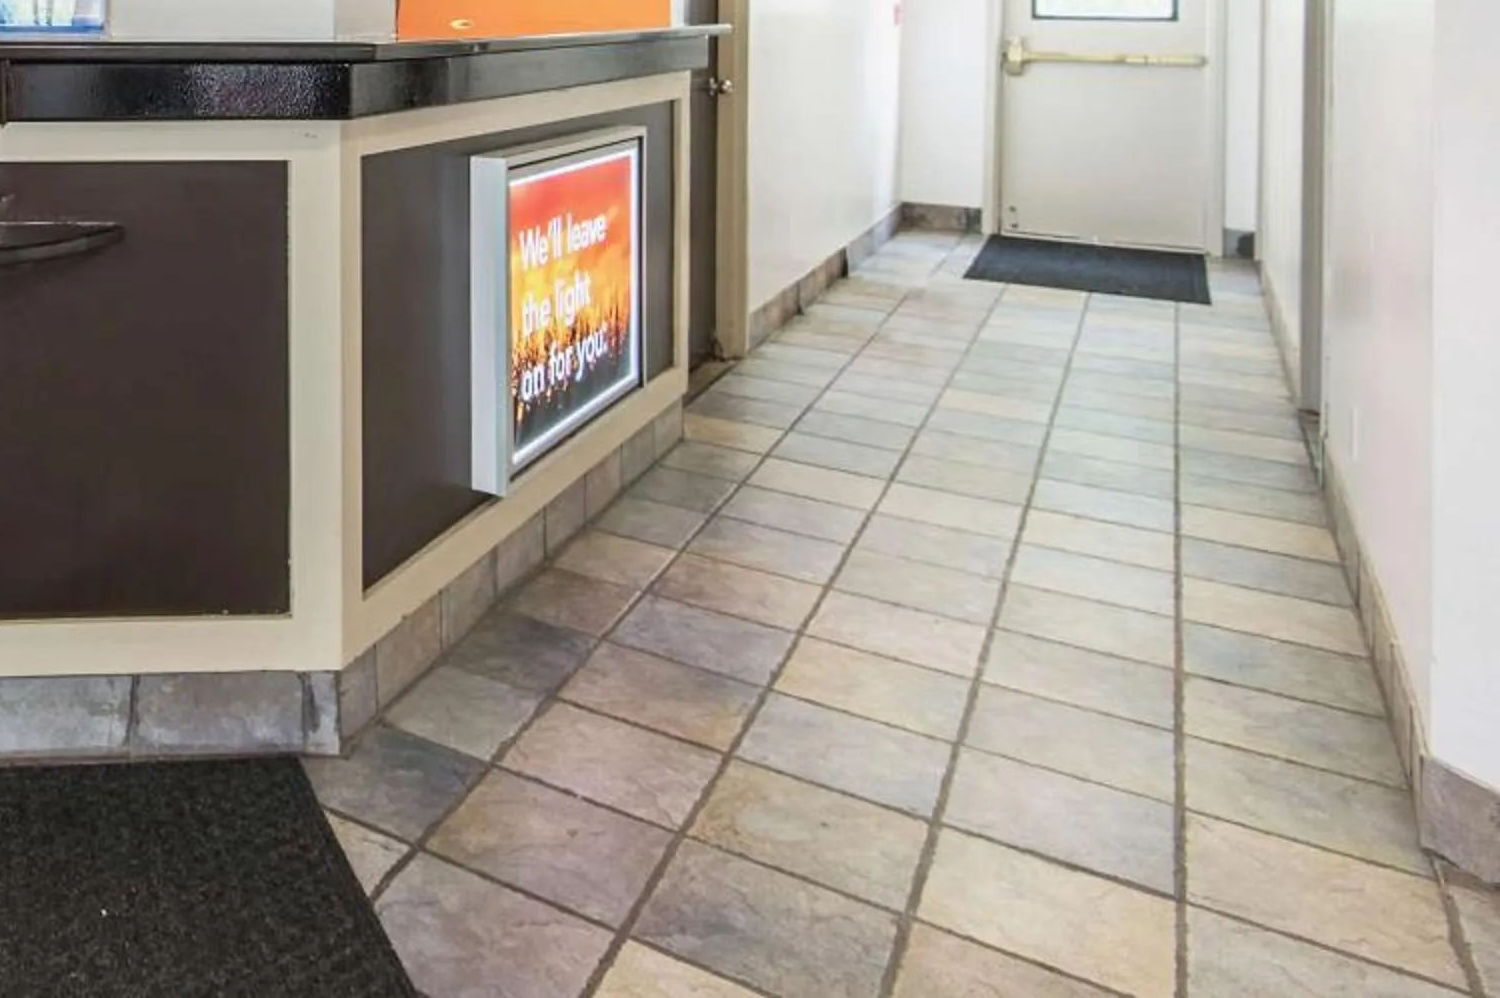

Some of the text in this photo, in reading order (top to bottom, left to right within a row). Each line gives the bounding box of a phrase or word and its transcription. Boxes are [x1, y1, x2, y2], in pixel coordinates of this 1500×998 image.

[518, 211, 608, 272] We'll leave
[522, 268, 591, 339] the light
[521, 363, 545, 401] on
[549, 340, 574, 386] for
